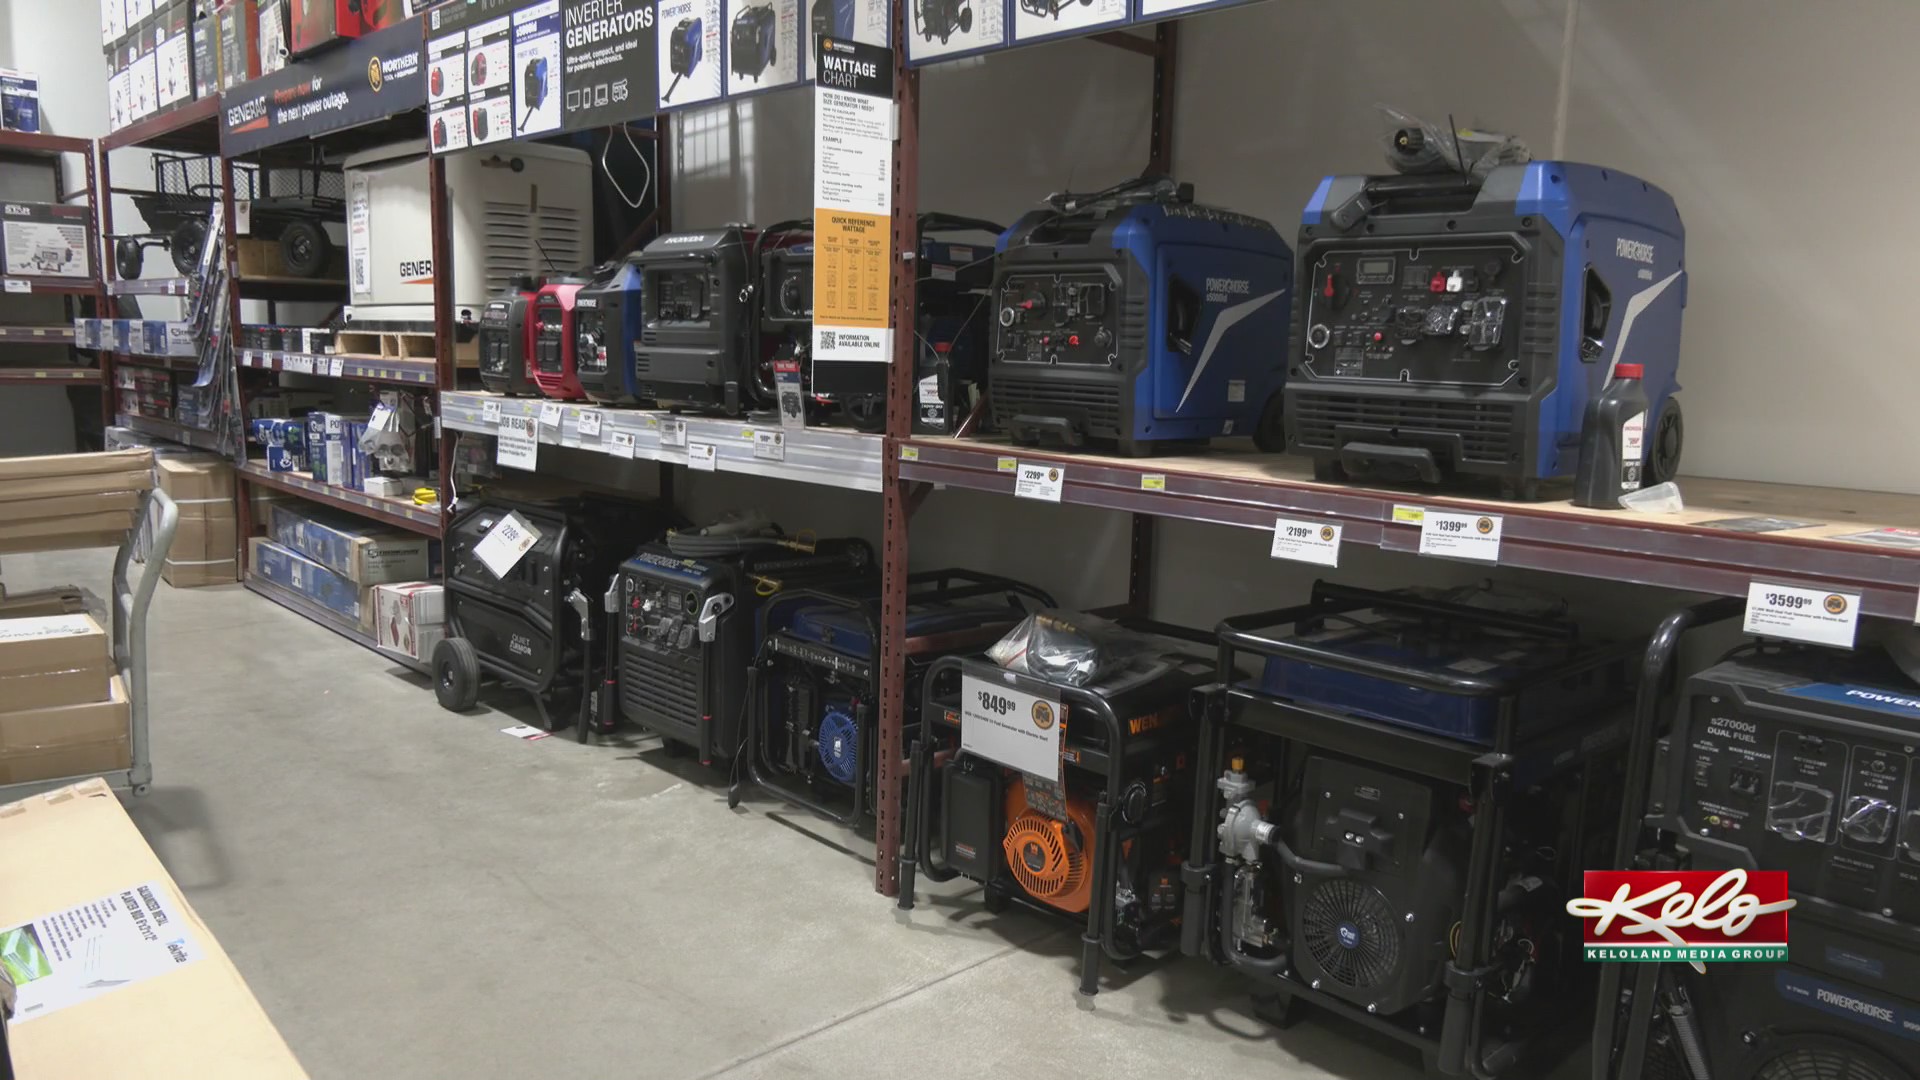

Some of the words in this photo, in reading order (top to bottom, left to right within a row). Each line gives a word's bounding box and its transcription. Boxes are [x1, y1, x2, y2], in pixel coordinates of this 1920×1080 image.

[565, 0, 623, 28] INVERTER
[566, 6, 654, 49] GENERATORS
[615, 42, 625, 53] and
[625, 39, 638, 50] ideal
[382, 52, 418, 73] NORTHERN
[566, 64, 574, 73] for
[573, 60, 595, 74] powering
[823, 55, 877, 78] WATTAGE
[311, 74, 322, 92] for
[823, 70, 857, 88] CHART
[228, 96, 267, 126] GENERAC
[277, 107, 288, 125] the
[287, 103, 302, 121] next
[301, 99, 323, 121] power
[322, 91, 349, 111] outage.
[823, 136, 842, 144] EXAMPLE
[831, 217, 848, 225] QUICK
[847, 218, 876, 228] REFERENCE
[842, 225, 866, 234] WATTAGE
[1616, 237, 1654, 265] POWERHORSE
[399, 261, 433, 277] GENER
[838, 334, 870, 342] INFORMATION
[838, 340, 864, 348] AVAILABLE
[864, 341, 881, 349] ONLINE
[1846, 690, 1920, 709] POWER
[1711, 717, 1756, 733] s27000d
[1707, 726, 1732, 739] DUAL
[1732, 731, 1757, 744] FUEL
[1743, 749, 1771, 760] BREAKER
[1816, 988, 1896, 1024] POWERHORSE
